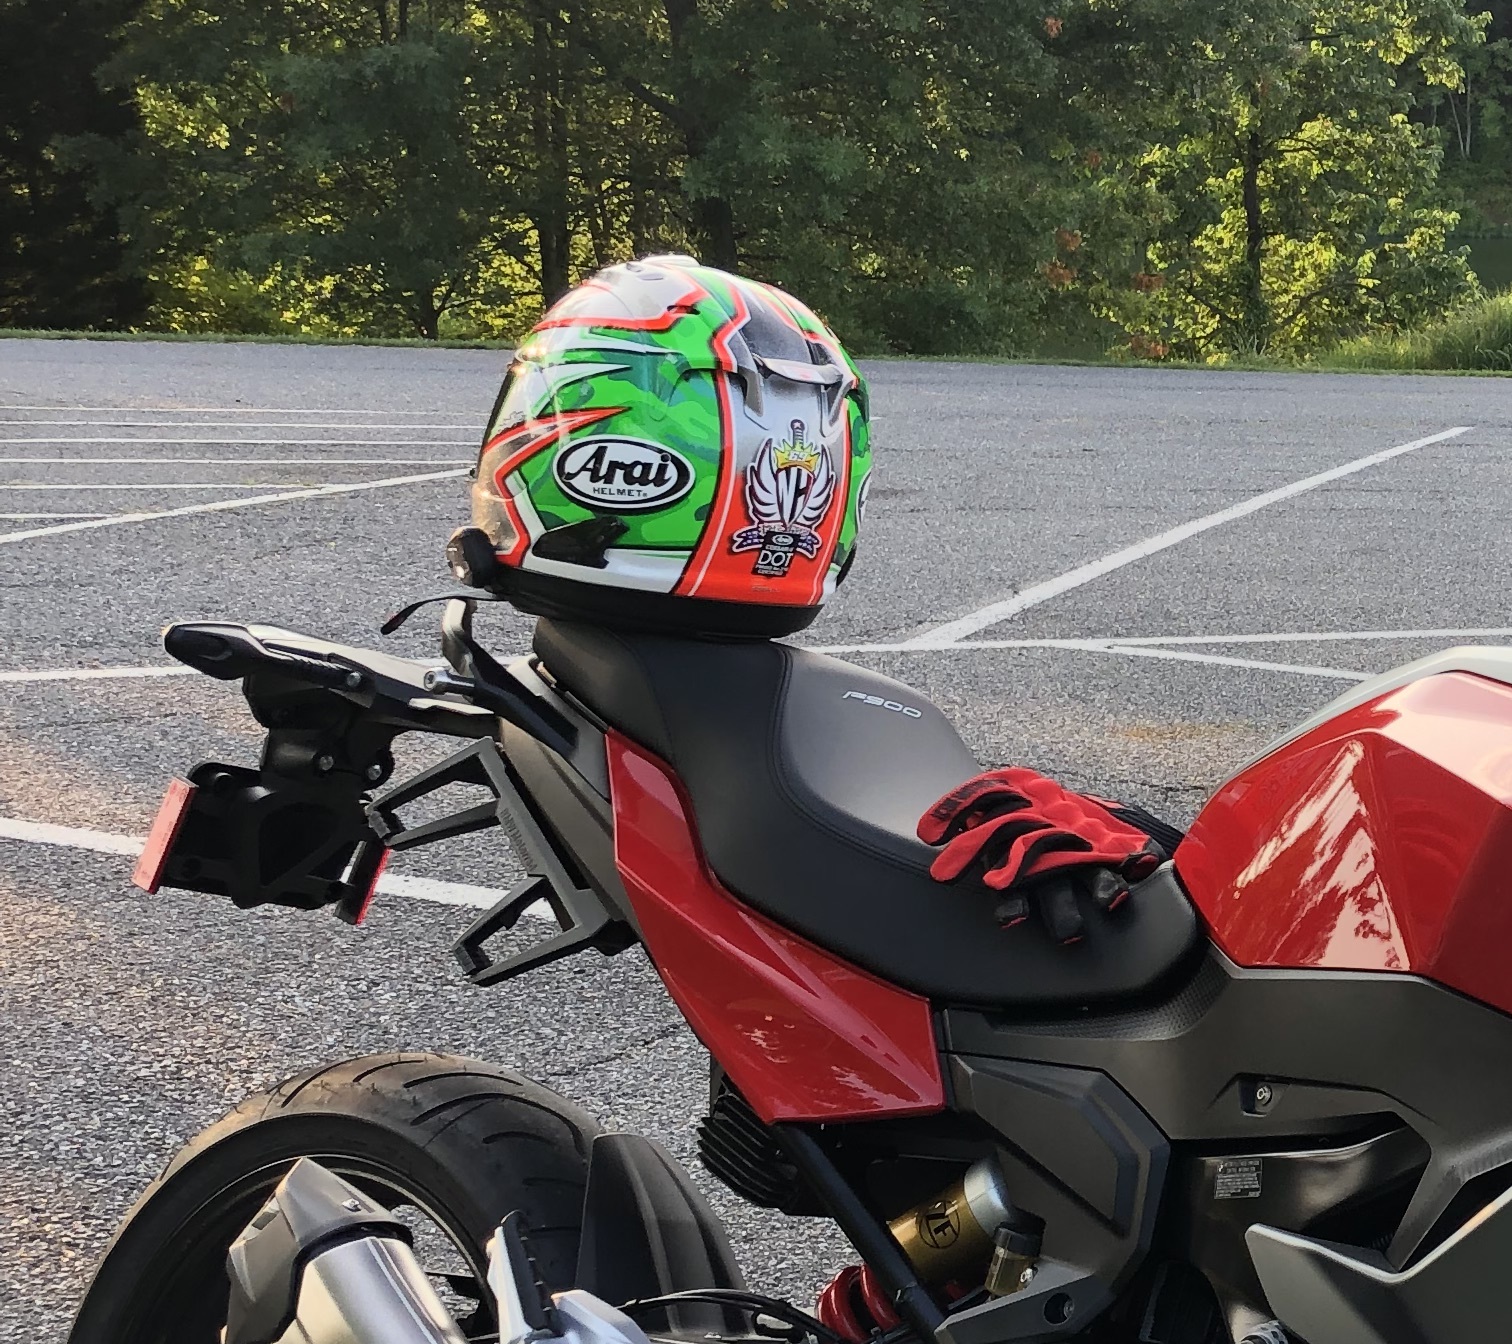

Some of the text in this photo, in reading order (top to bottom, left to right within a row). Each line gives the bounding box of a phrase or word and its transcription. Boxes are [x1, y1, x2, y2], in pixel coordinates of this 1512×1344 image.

[563, 444, 672, 487] Arai
[593, 487, 643, 497] HELMET
[757, 550, 794, 567] DOT
[842, 690, 922, 719] F900
